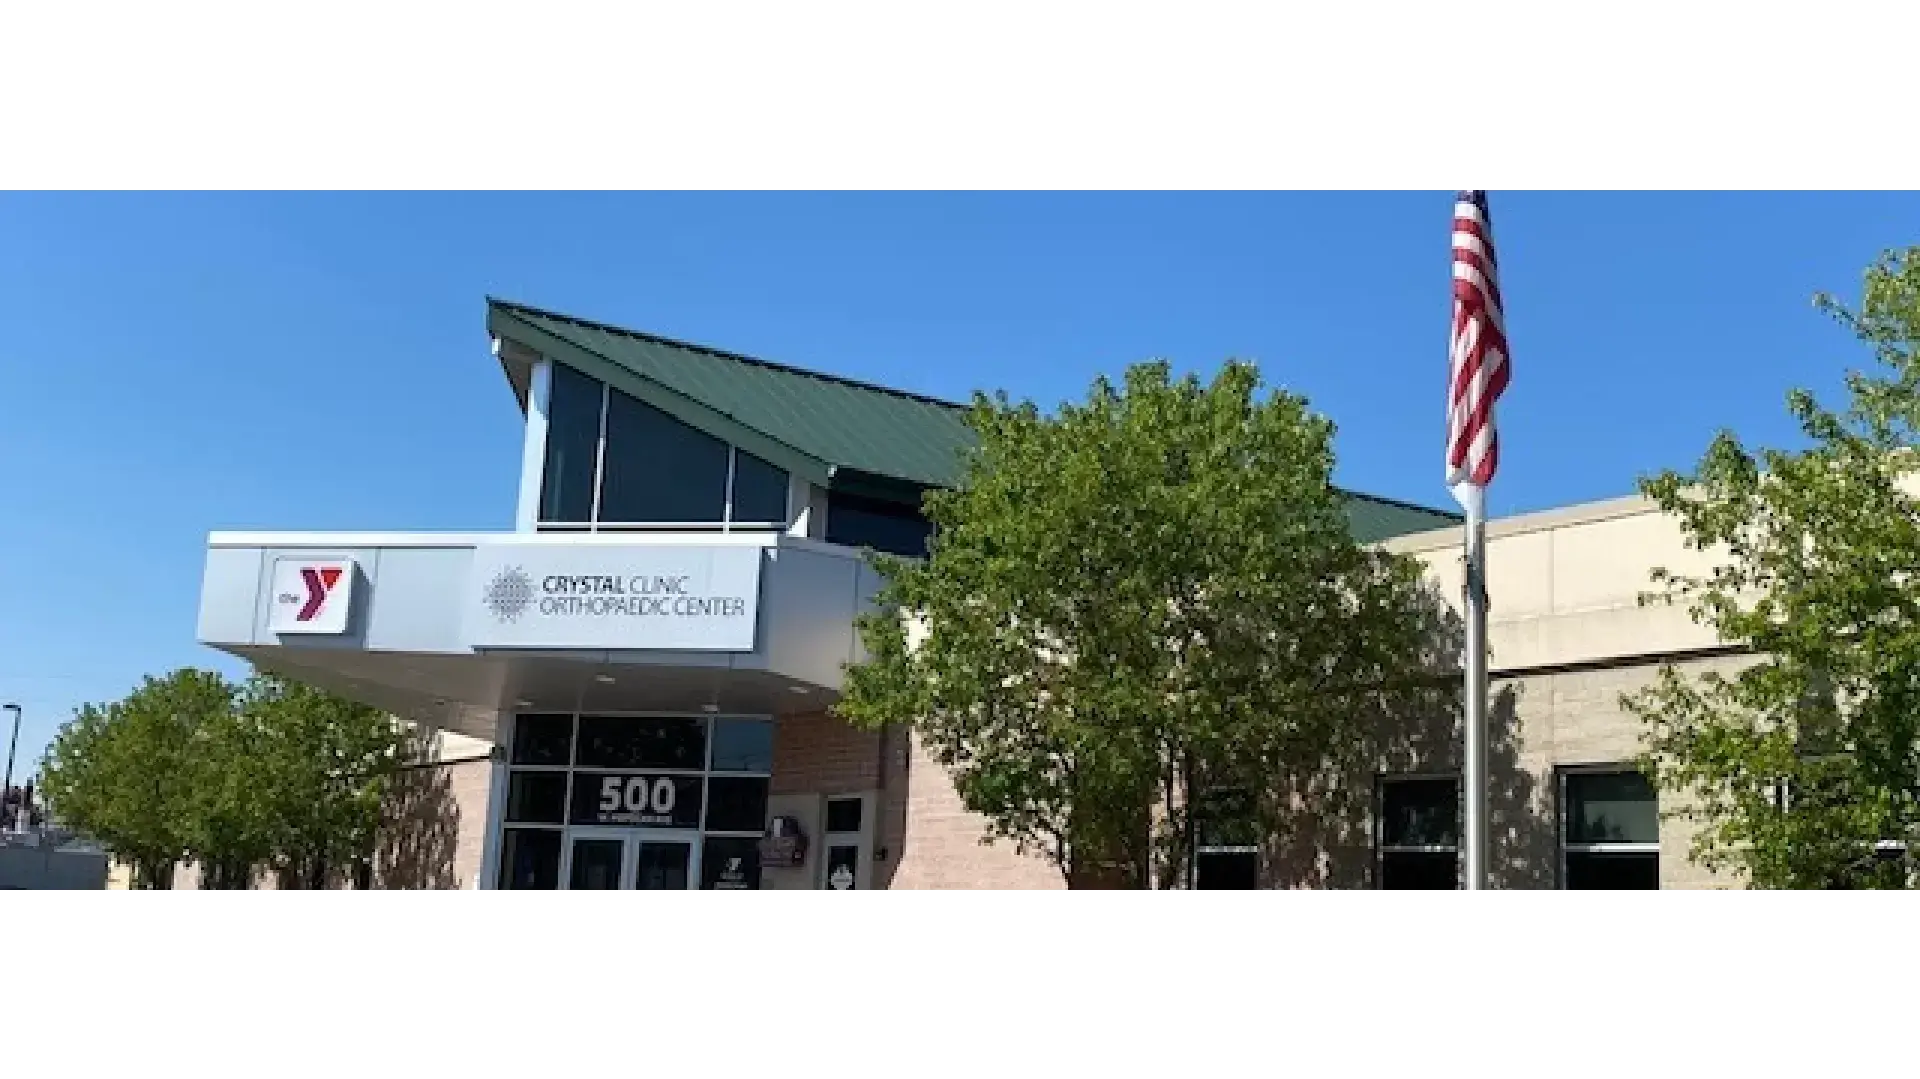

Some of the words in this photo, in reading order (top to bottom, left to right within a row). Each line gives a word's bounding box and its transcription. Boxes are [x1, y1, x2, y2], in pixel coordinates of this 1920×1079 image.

[297, 567, 343, 622] Y
[542, 575, 625, 595] CRYSTAL
[629, 575, 690, 595] CLINIC
[539, 596, 670, 616] ORTHOPAEDIC
[674, 596, 745, 616] CENTER
[600, 776, 676, 813] 500
